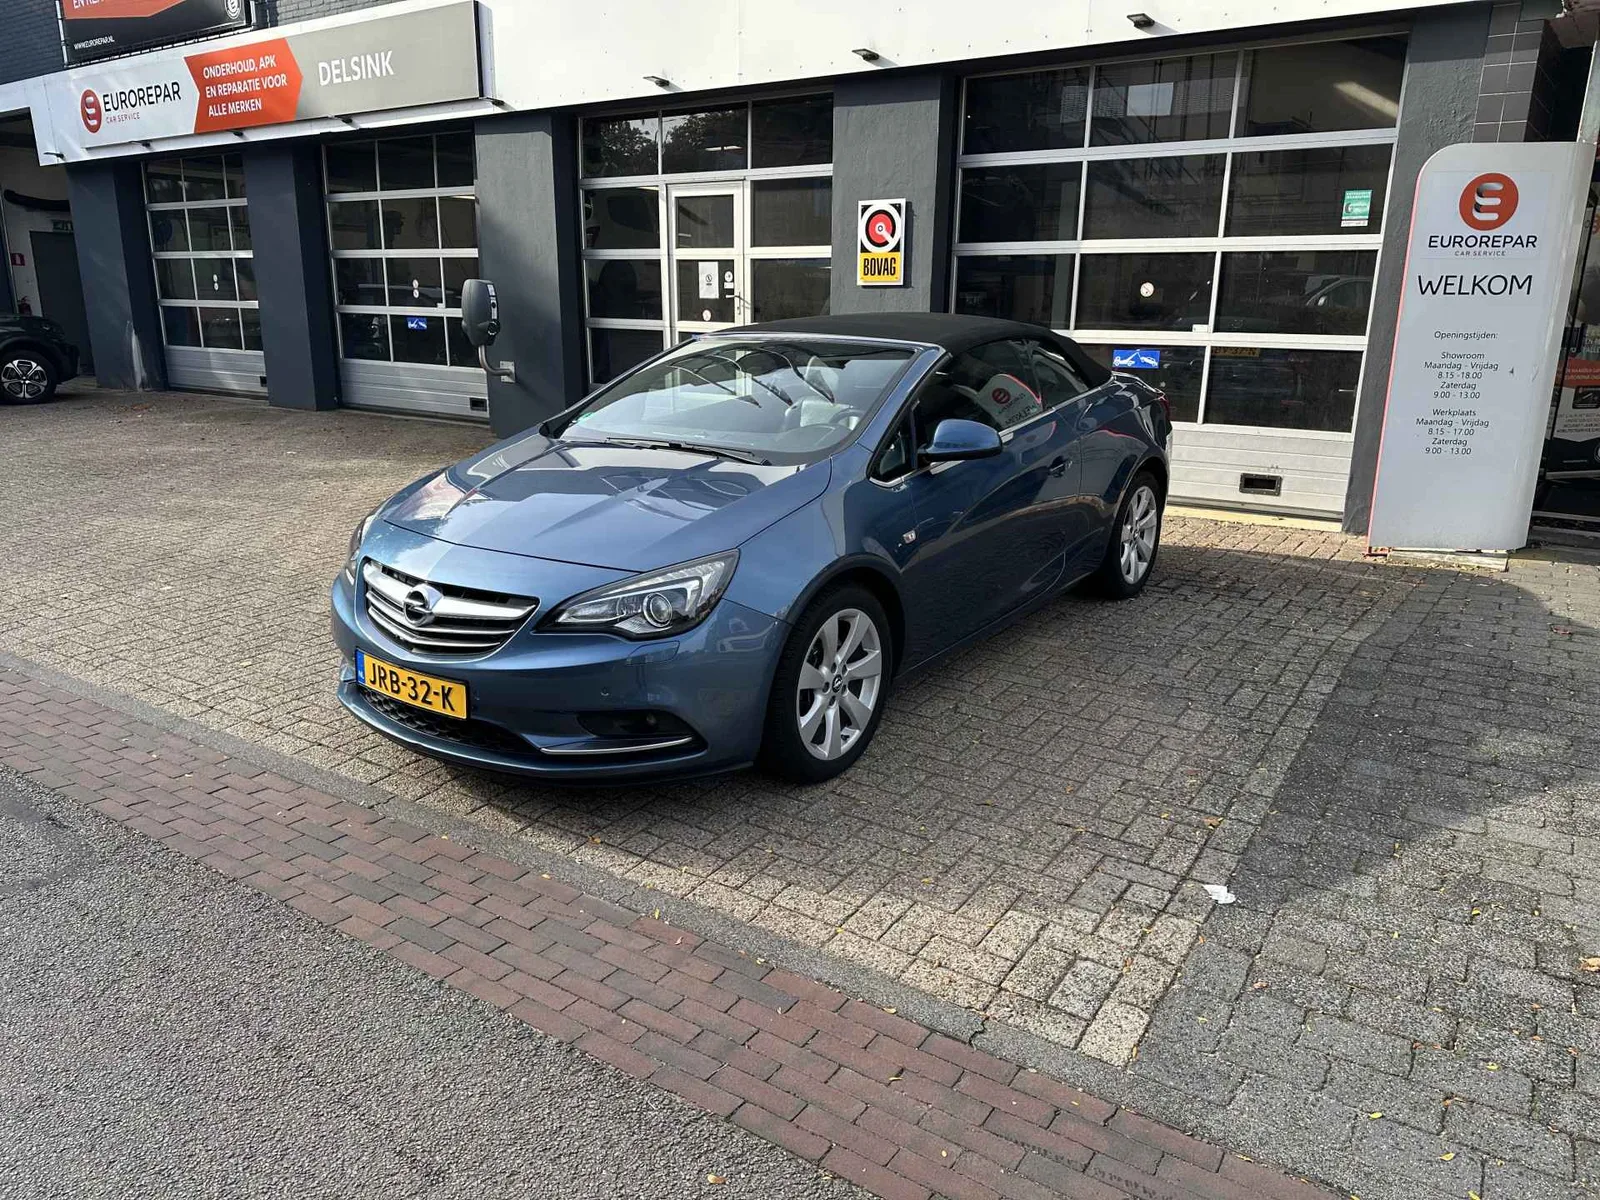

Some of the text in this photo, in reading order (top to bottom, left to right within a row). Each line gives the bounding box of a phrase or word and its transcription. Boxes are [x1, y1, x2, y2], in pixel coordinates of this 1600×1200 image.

[203, 54, 276, 79] ONDERHOUD, APK
[318, 50, 394, 86] DELSINK
[205, 73, 287, 98] EN REPARATIE VOOR
[103, 81, 181, 112] EUROREPAR
[208, 98, 262, 117] ALLE MERKEN
[106, 112, 140, 124] CAR SERVICE
[1428, 235, 1538, 248] EUROREPAR
[863, 257, 897, 276] BOVAG
[1418, 275, 1533, 296] WELKOM
[1434, 330, 1498, 340] Openingstijden:
[1441, 351, 1485, 359] Showroom
[1424, 361, 1462, 370] Maandag
[1470, 362, 1499, 371] Vrijdag
[1440, 381, 1477, 390] Zaterdag
[1432, 409, 1476, 417] Werkplaats
[1415, 418, 1453, 427] Maandag
[1461, 419, 1489, 428] Vrijdag
[1431, 438, 1468, 447] Zaterdag
[369, 663, 455, 712] JRB-32-K
